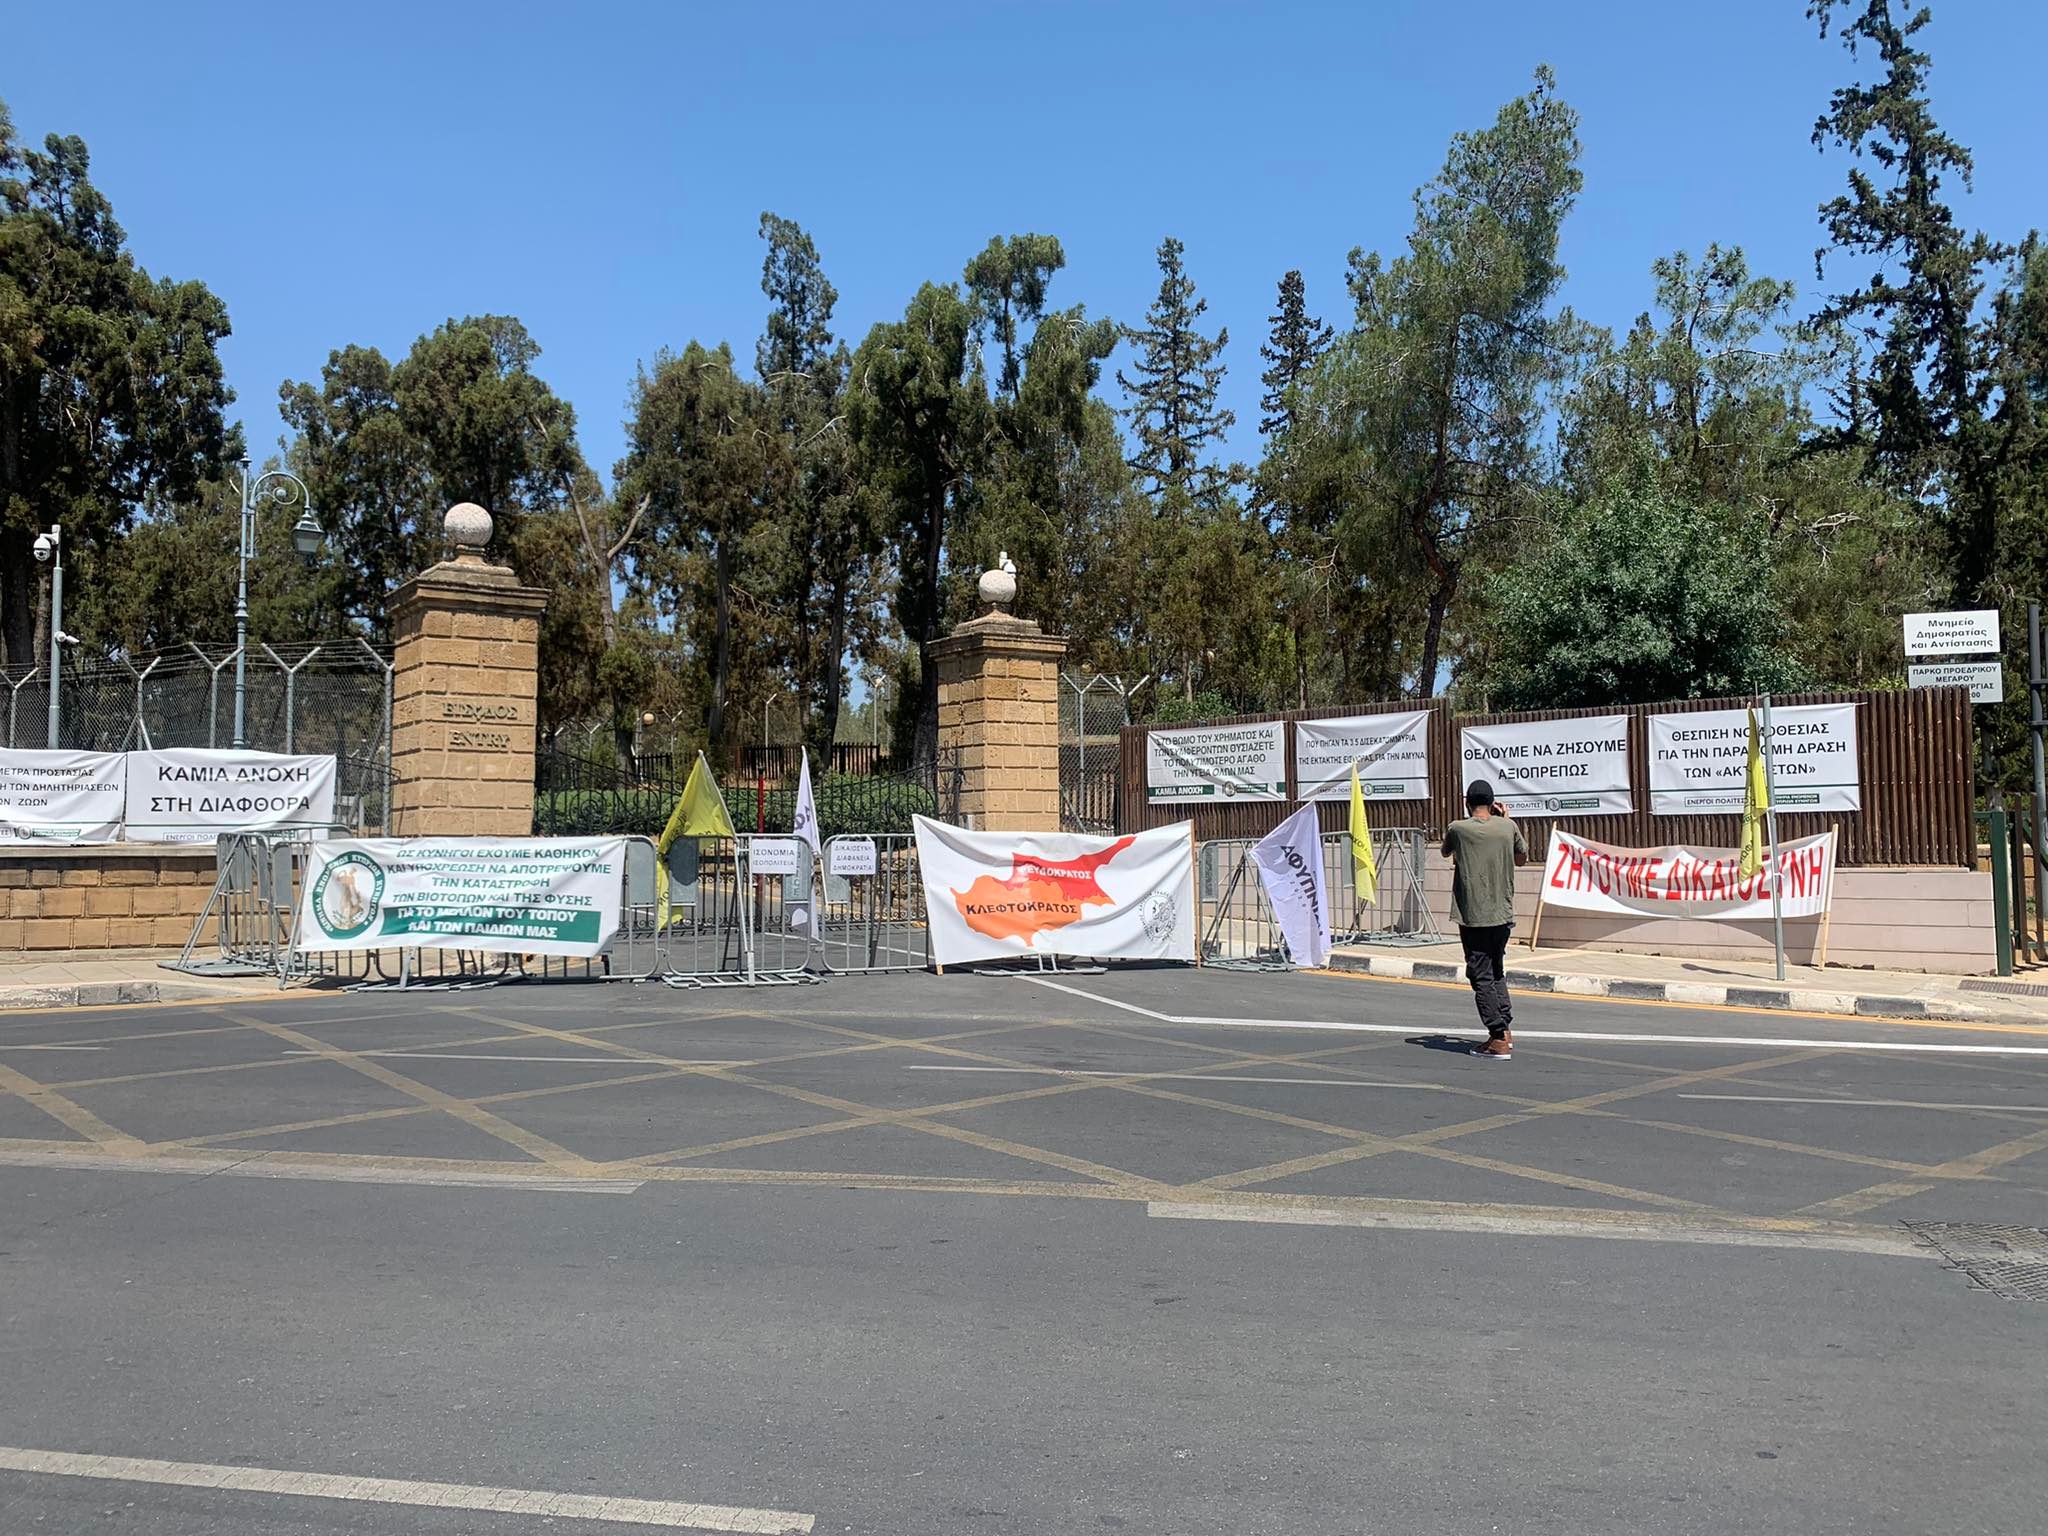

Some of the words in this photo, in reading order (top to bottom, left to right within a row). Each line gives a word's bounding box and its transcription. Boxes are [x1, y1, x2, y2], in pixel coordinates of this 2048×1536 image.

[1928, 617, 1975, 628] Μνημείο
[1916, 628, 1988, 639] Δημοκρατίας
[1930, 639, 1994, 649] Αντίστασης
[1912, 668, 1942, 676] ΠΑΡΚΟ
[1943, 666, 1998, 675] ΠΡΟΕΔΡΙΚΟΥ
[1935, 675, 1975, 683] ΜΕΓΑΡΟΥ
[449, 730, 511, 748] ENTRY
[1172, 735, 1196, 745] ΒΩΜΟ
[1197, 734, 1213, 744] ΤΟΥ
[1214, 731, 1257, 743] ΧΡΗΜΑΤΟΣ
[1258, 729, 1273, 740] ΚΑΙ
[1671, 728, 1729, 742] ΘΕΣΠΙΣΗ
[1229, 741, 1275, 753] ΘΥΣΙΑΖΕΤΕ
[1306, 740, 1319, 748] ΠΟΥ
[1320, 738, 1340, 748] ΠΗΓΑΝ
[1341, 738, 1349, 747] ΤΑ
[1387, 752, 1400, 760] ΤΗΝ
[1464, 745, 1529, 761] ΘΕΛΟΥΜΕ
[1533, 744, 1552, 756] ΝΑ
[1556, 739, 1626, 755] ΖΗΣΟΥΜΕ
[1658, 748, 1679, 760] ΓΙΑ
[1682, 747, 1709, 760] ΤΗΝ
[1712, 744, 1793, 759] ΠΑΡΑΟΜΗ
[1796, 741, 1846, 755] ΔΡΑΣΗ
[1164, 759, 1174, 768] ΤΟ
[1236, 753, 1266, 764] ΑΓΑΘΟ
[32, 768, 95, 777] ΠΡΟΣΤΑΣΙΑΣ
[158, 766, 229, 782] ΚΑΜΙΑ
[235, 767, 310, 782] ΑΝΟΧΗ
[1173, 769, 1189, 778] ΤΗΝ
[1212, 767, 1236, 777] ΟΛΩΝ
[1237, 766, 1255, 775] ΜΑΣ
[1498, 764, 1589, 780] ΑΞΙΟΠΡΕΠΩΣ
[1684, 766, 1711, 779] ΤΩΝ
[9, 782, 30, 791] ΤΩΝ
[32, 783, 120, 792] ΔΗΛΗΤΗΡΙΑΣΕΩΝ
[1155, 786, 1176, 796] ΚΑΜΙΑ
[1177, 786, 1203, 796] ΑΝΟΧΗ
[17, 798, 48, 807] ΖΩΩΝ
[151, 797, 192, 812] ΣΤΗ
[199, 796, 311, 813] ΔΙΑΦΘΟΡΑ
[1687, 798, 1714, 806] ΕΝΕΡΓΟΙ
[396, 849, 416, 858] ΩΣ
[416, 849, 474, 858] ΚΥΝΗΓΟΙ
[476, 849, 531, 858] ΕΧΟΥΜΕ
[535, 848, 600, 858] ΚΑΘΗΚΟΝ
[753, 848, 795, 857] ΙΣΟΝΟΜΙΑ
[407, 863, 486, 873] ΥΠΟΧΡΕΩΣΗ
[488, 864, 507, 874] ΝΑ
[510, 863, 612, 874] ΑΠΟΤΡΕΨΟΥΜΕ
[1551, 843, 1663, 899] ΖΗΤΟΥΜΕ
[432, 877, 459, 887] ΤΗΝ
[462, 878, 550, 889] ΚΑΤΑΣΤΡΟΦΗ
[393, 893, 415, 903] ΤΩΝ
[417, 892, 486, 903] ΒΙΟΤΟΠΩΝ
[488, 893, 510, 902] ΚΑΙ
[514, 893, 541, 904] ΤΗΣ
[545, 894, 592, 906] ΦΥΣΗΣ
[966, 902, 1078, 914] ΚΛΕΦΤΟΚΡΑΤΟΣ
[416, 907, 435, 917] ΤΟ
[496, 908, 526, 919] ΤΟΥ
[528, 909, 578, 922] ΤΟΠΟΥ
[408, 920, 431, 931] ΚΑΙ
[433, 921, 462, 932] ΤΩΝ
[464, 923, 524, 936] ΠΑΙΔΙΩΝ
[526, 925, 558, 938] ΜΑΣ
